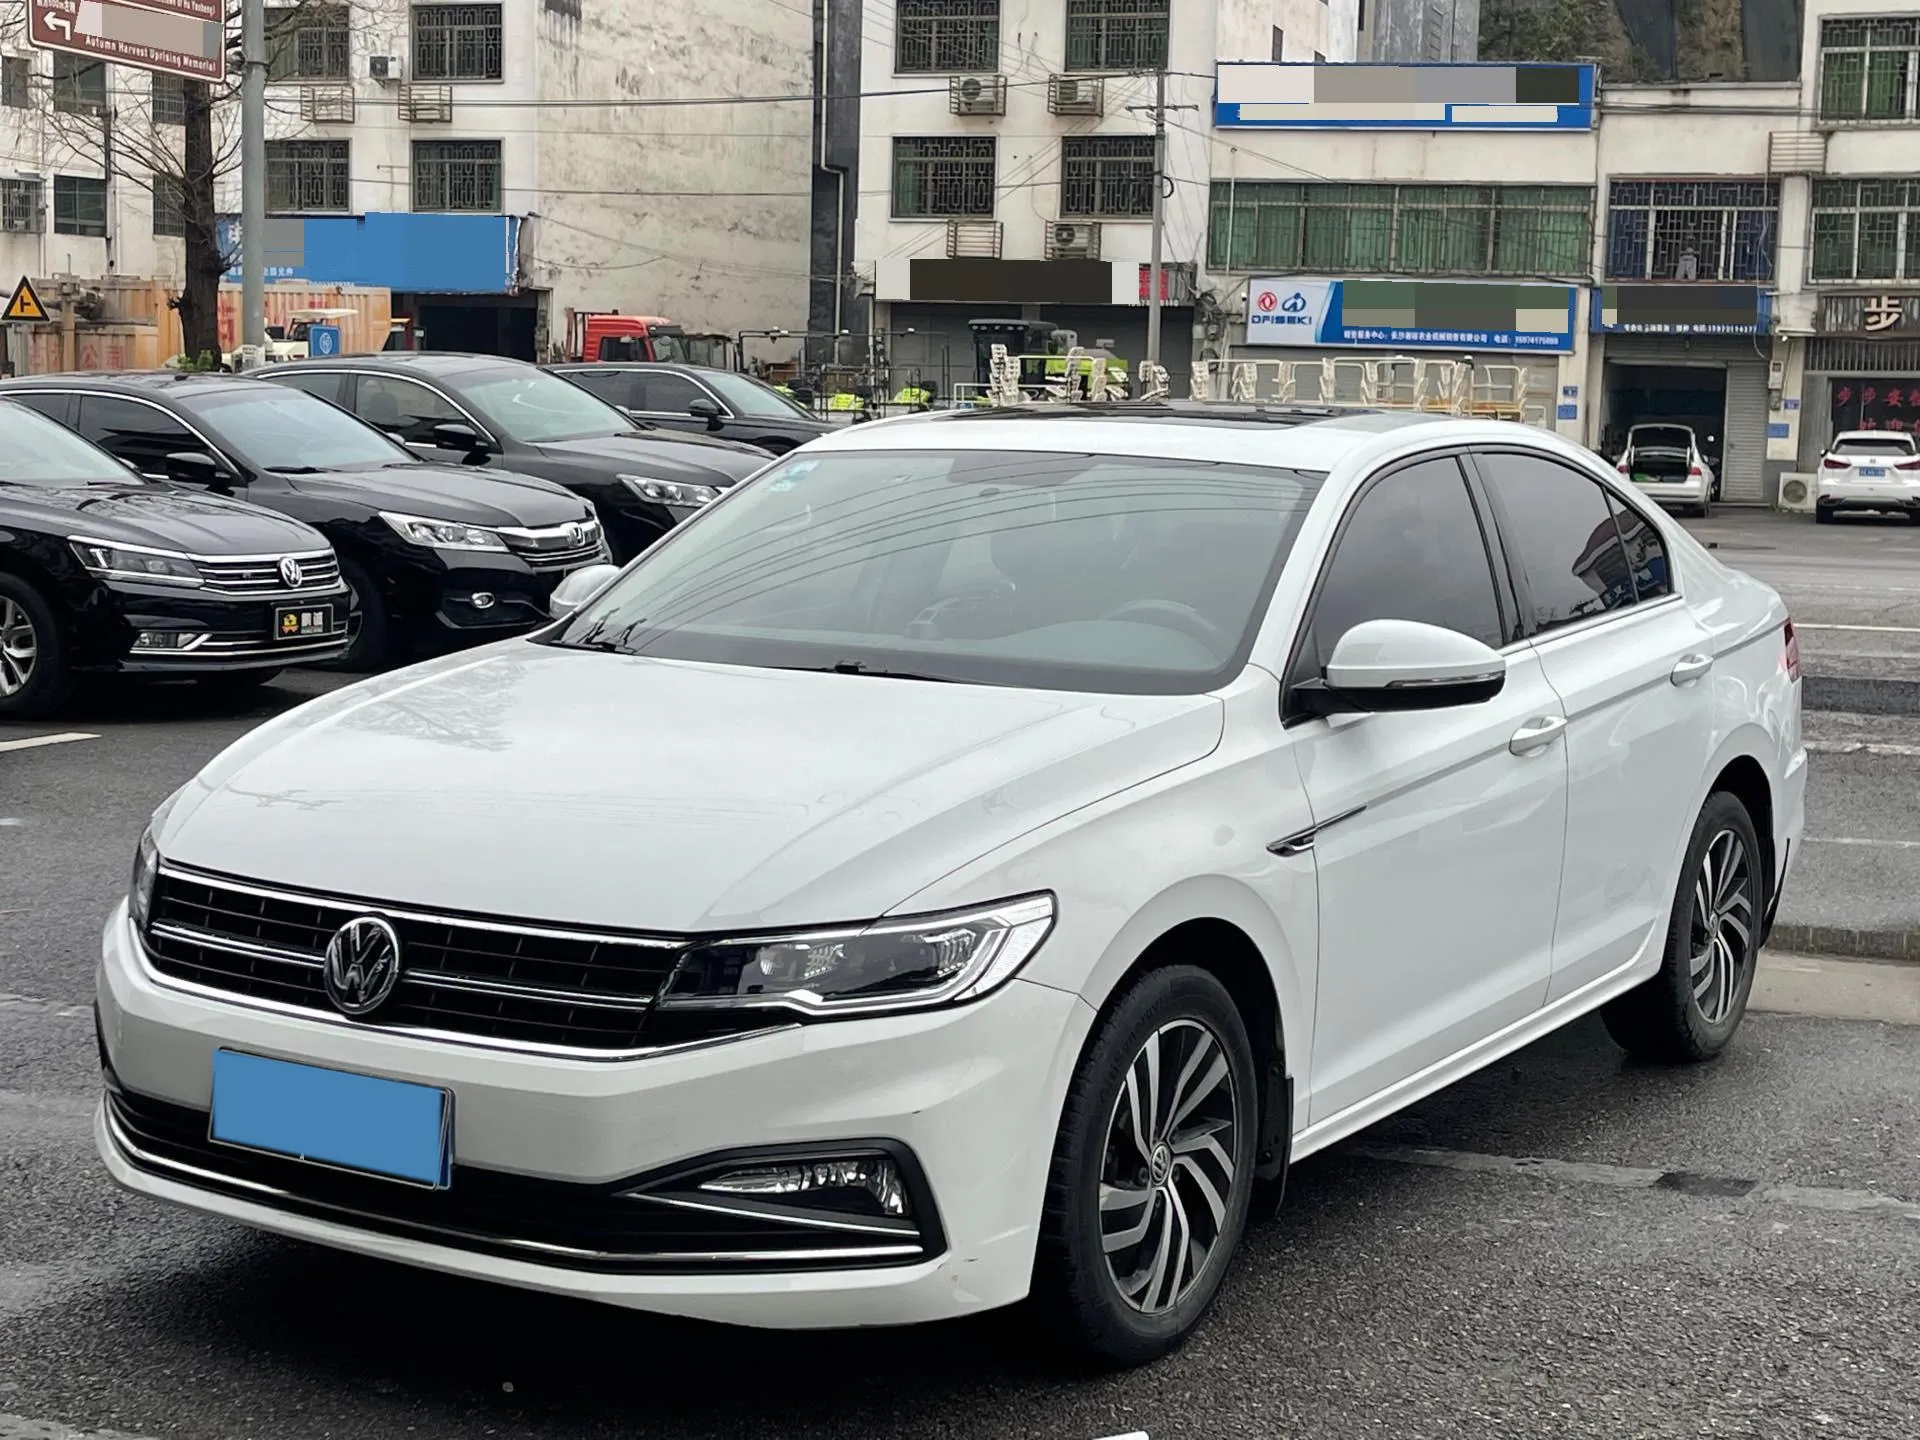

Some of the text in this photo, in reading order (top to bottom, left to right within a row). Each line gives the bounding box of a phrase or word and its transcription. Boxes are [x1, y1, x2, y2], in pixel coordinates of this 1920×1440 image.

[85, 35, 216, 72] Autumn Harvest Uprising Memorial
[1864, 296, 1903, 331] 步
